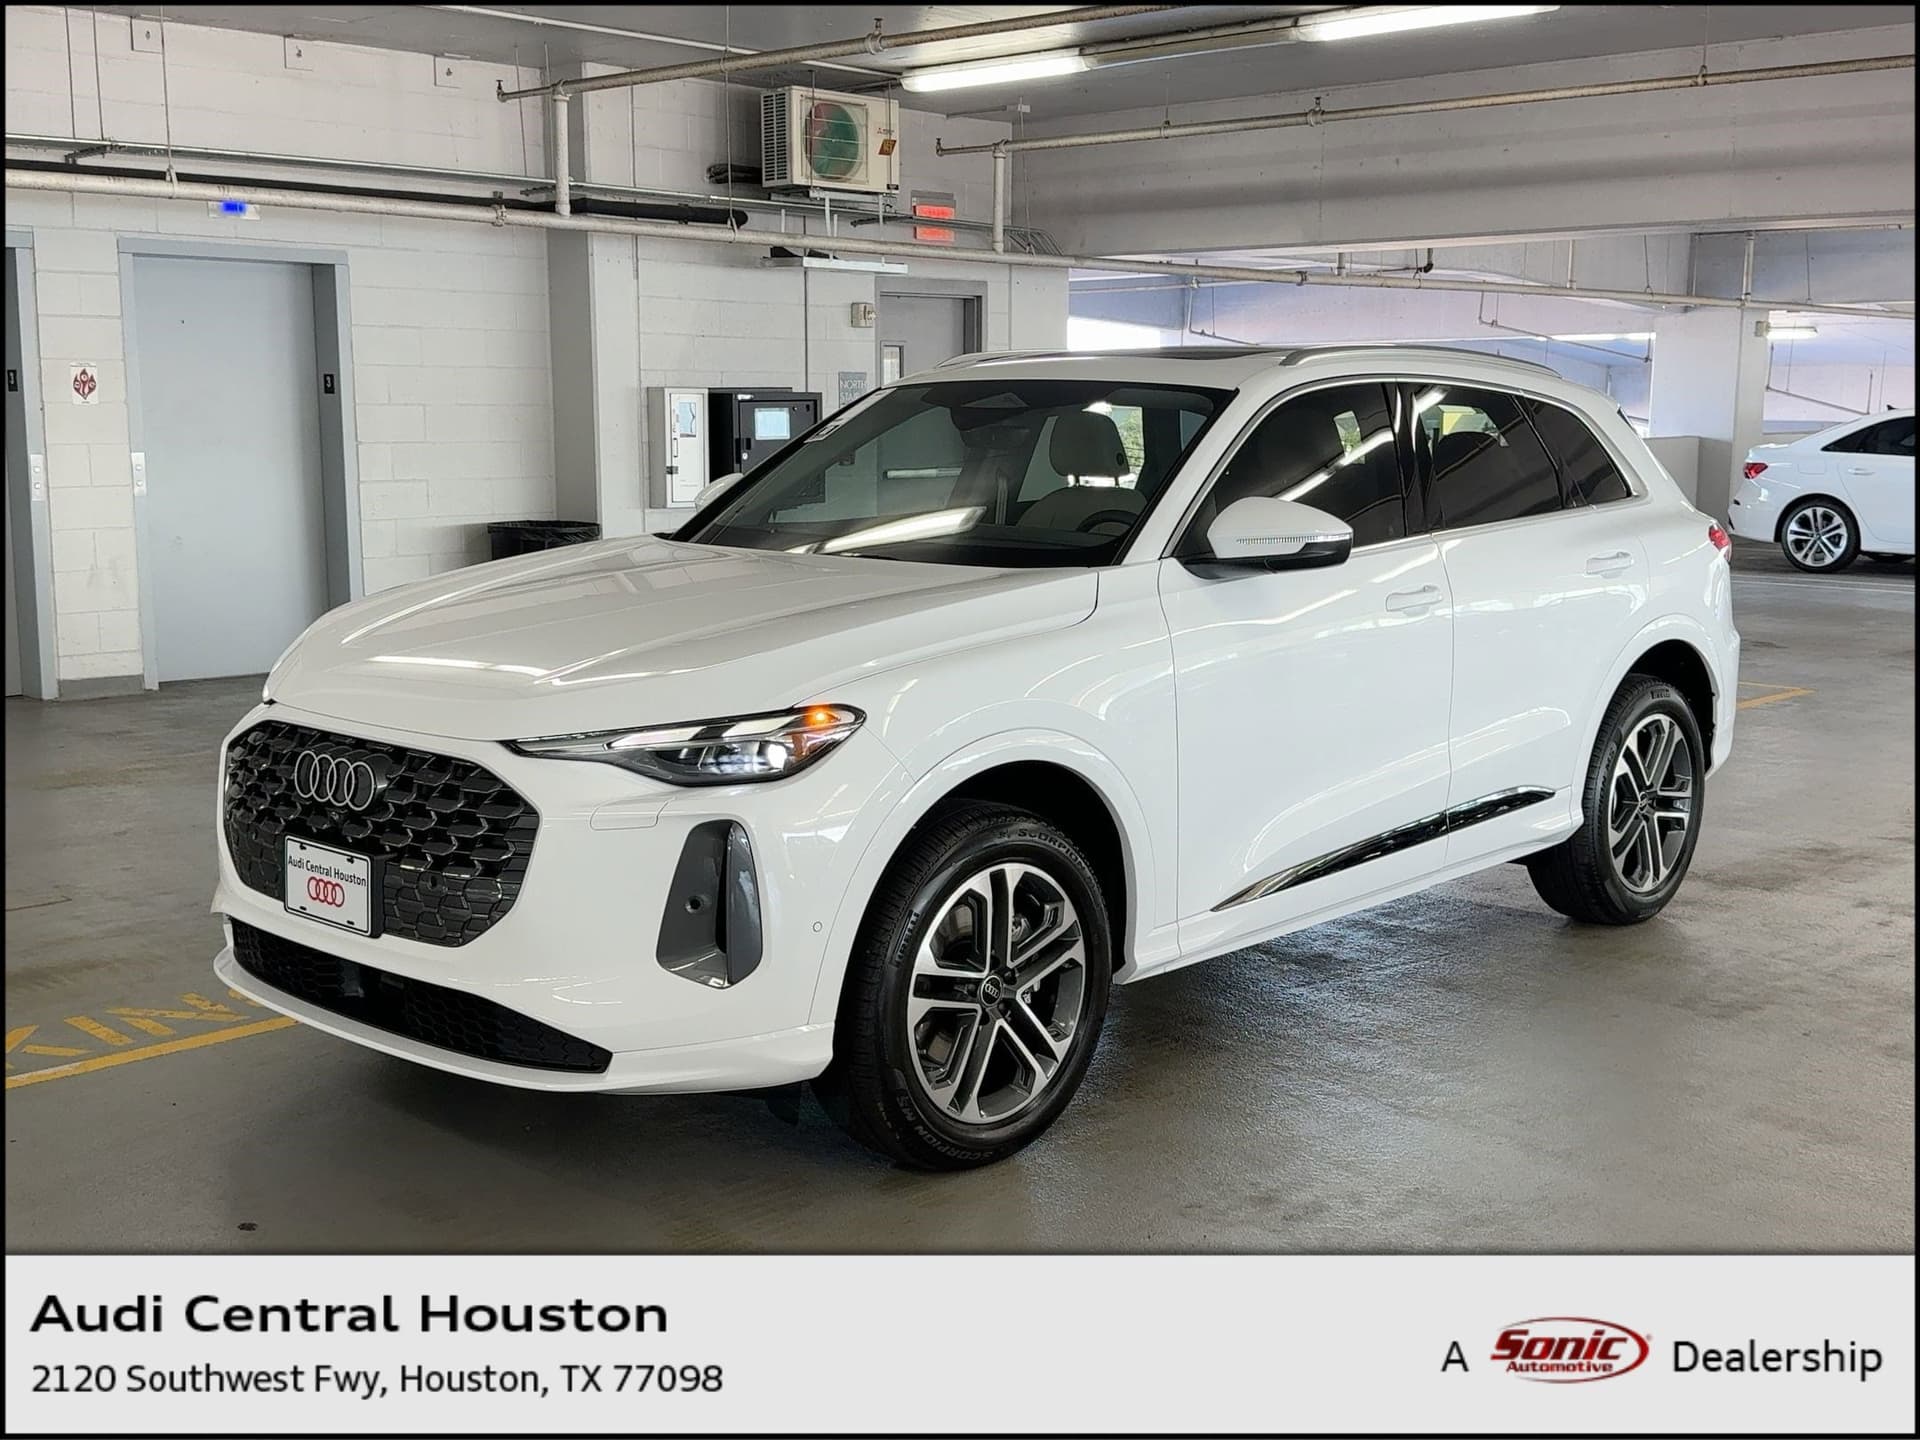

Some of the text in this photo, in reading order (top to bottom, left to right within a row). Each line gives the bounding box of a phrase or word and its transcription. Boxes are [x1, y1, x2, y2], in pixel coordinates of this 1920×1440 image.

[288, 855, 366, 887] Audi Central Houston
